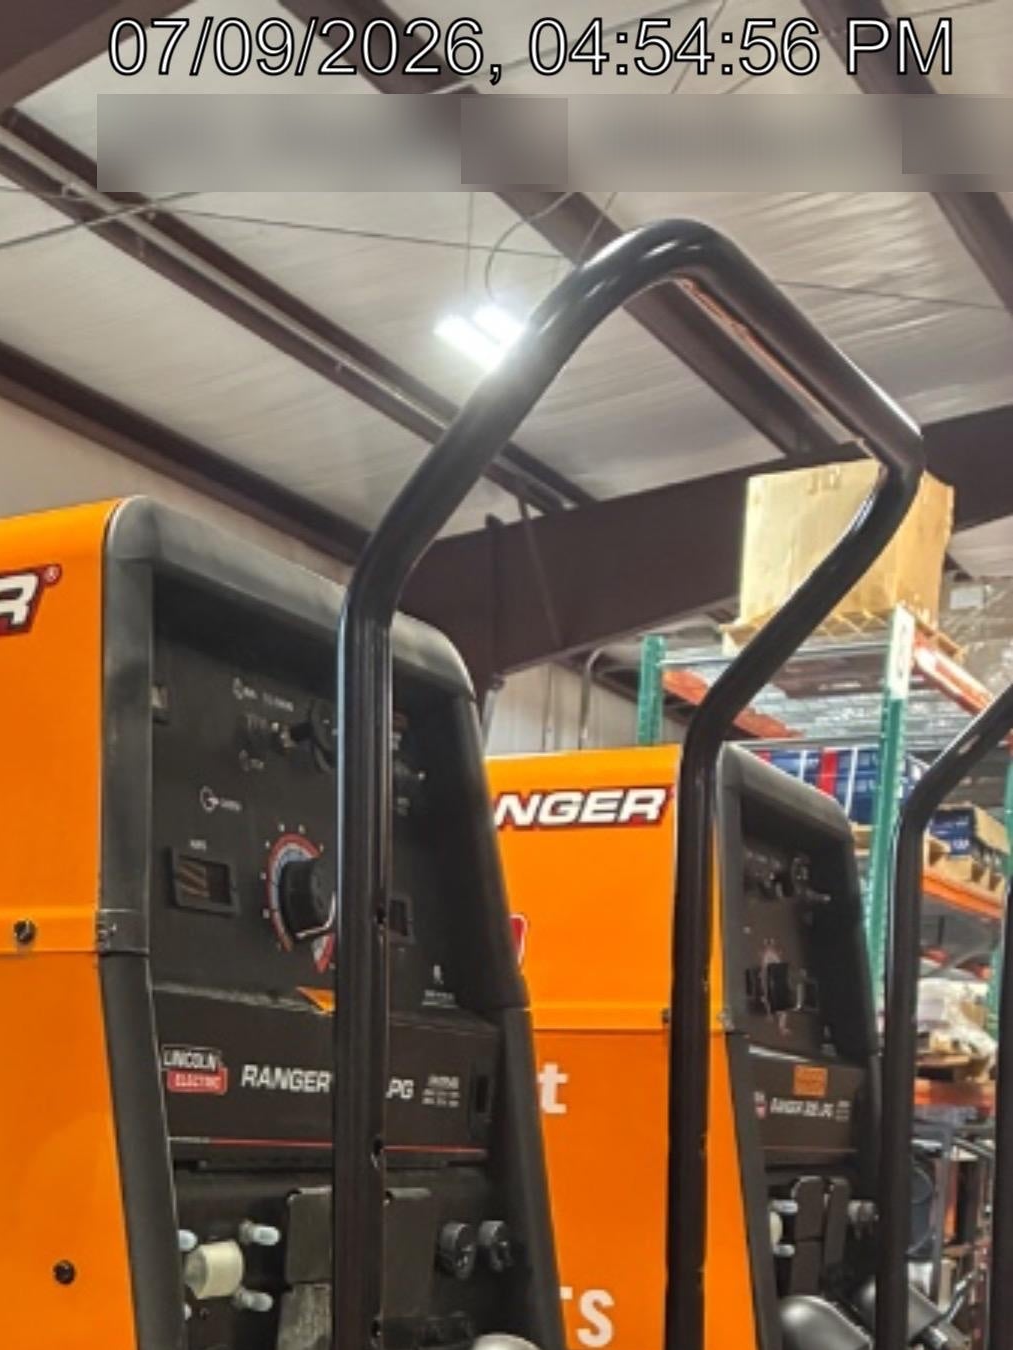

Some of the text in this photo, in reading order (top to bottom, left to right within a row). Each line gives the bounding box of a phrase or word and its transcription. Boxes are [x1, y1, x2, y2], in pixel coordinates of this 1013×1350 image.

[494, 789, 666, 826] NGER
[164, 1049, 217, 1070] LINCOLN
[241, 1063, 331, 1093] RANGER
[386, 1078, 415, 1099] PG
